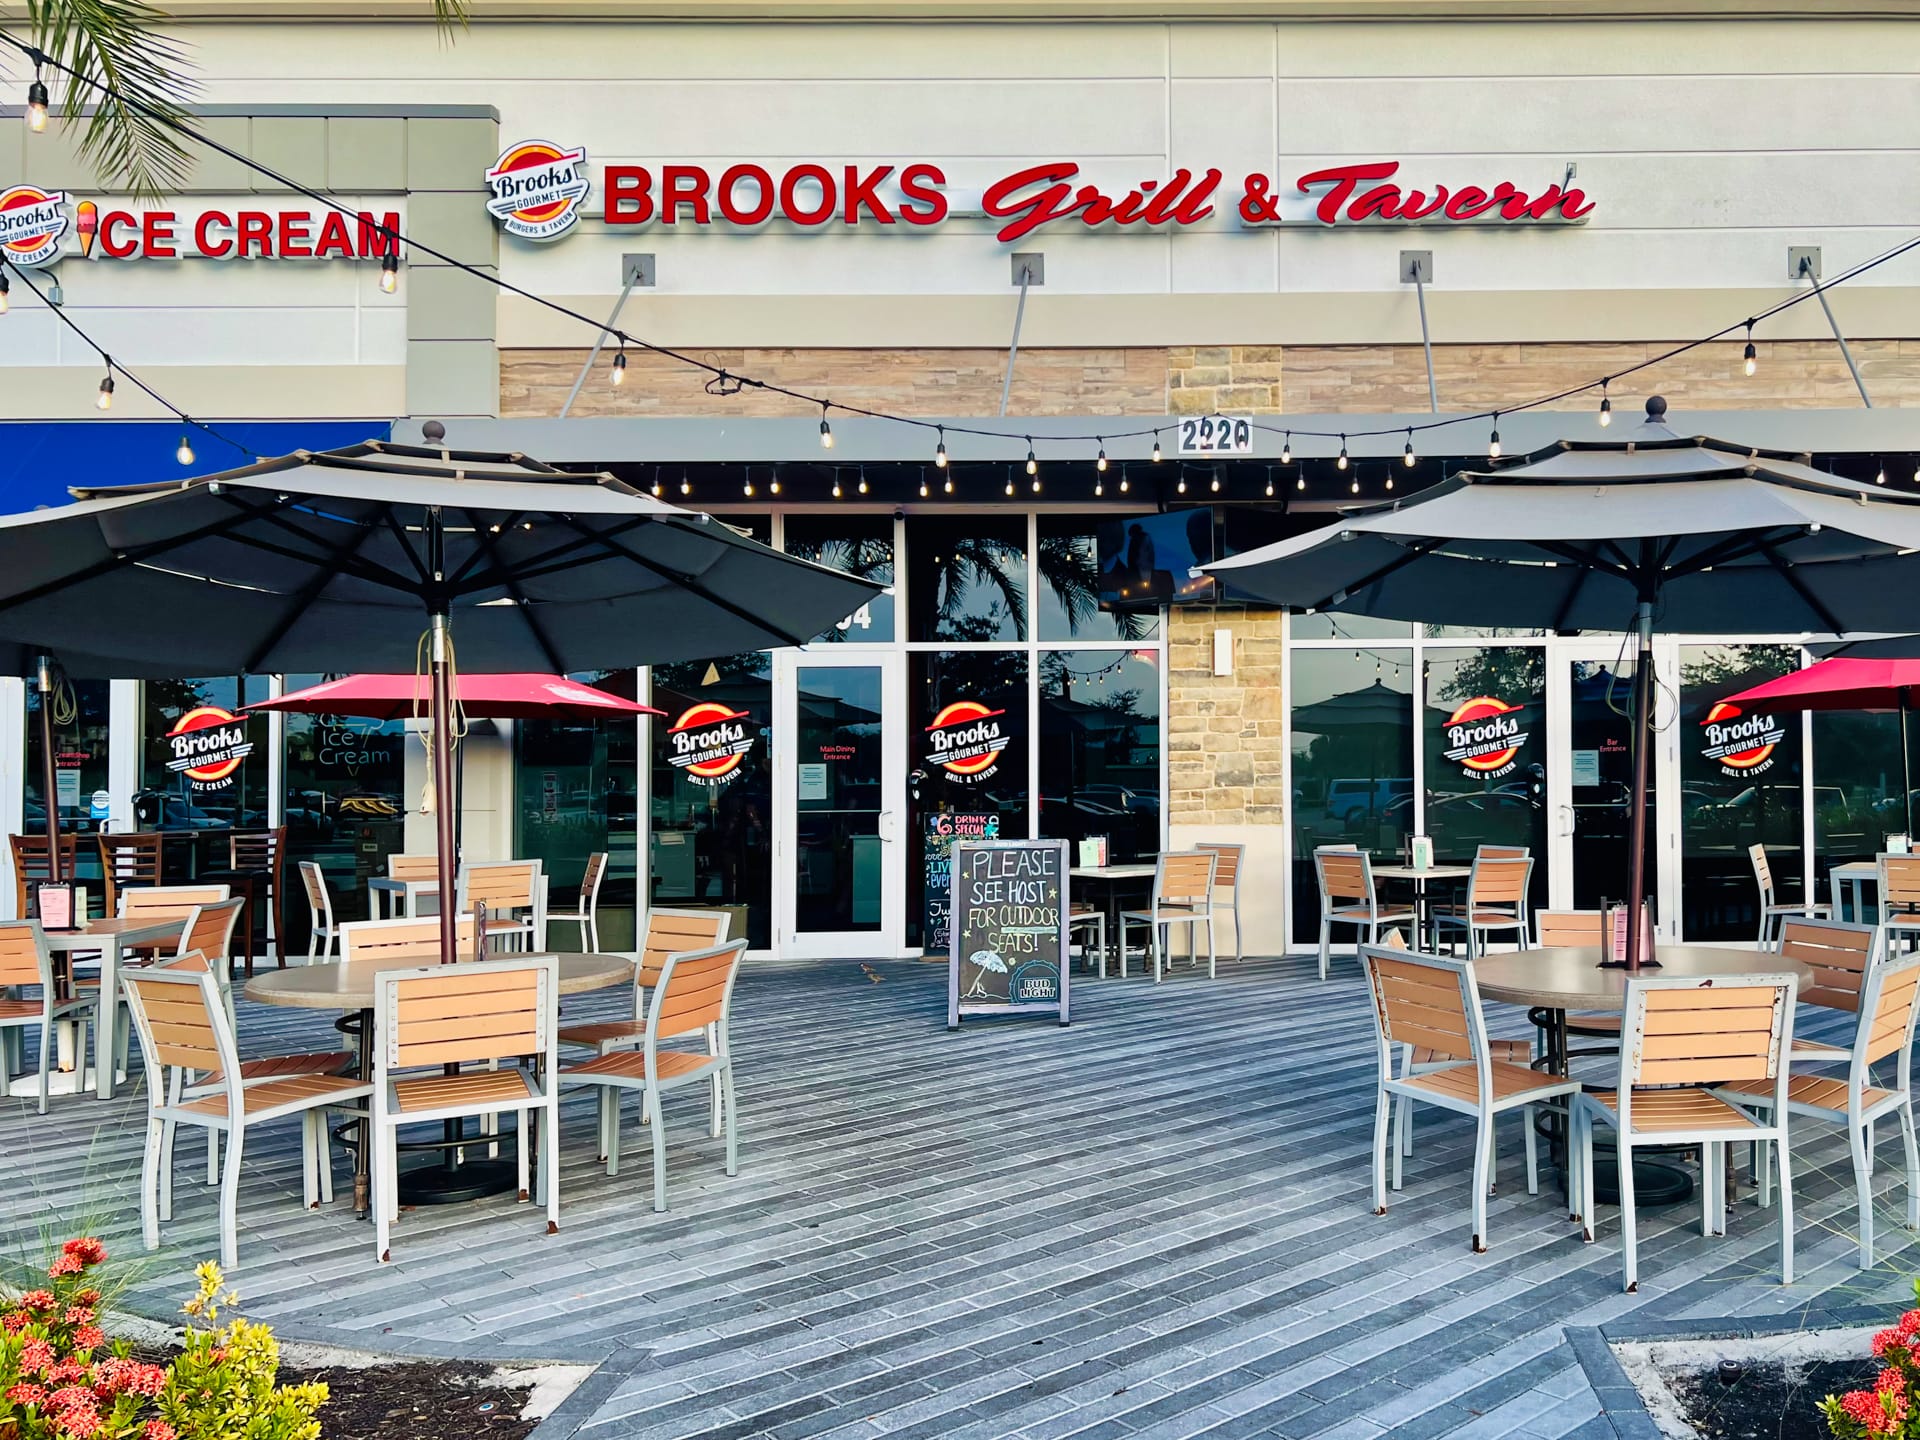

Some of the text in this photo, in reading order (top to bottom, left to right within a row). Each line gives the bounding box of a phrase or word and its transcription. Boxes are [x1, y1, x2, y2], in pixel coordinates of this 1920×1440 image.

[496, 167, 573, 199] Brooks
[517, 190, 561, 209] GOURMET
[604, 161, 1596, 243] BROOKS Grill & Tavern
[0, 207, 54, 232] Brooks
[508, 219, 539, 234] BURGERS
[549, 211, 574, 231] TAVERN
[9, 226, 45, 241] GOURMET
[195, 210, 400, 257] CREAM
[7, 246, 50, 262] ICE CREAM
[1182, 419, 1249, 450] 2220
[322, 730, 355, 746] Ice
[672, 723, 744, 754] Brooks
[930, 721, 1000, 752] Brooks
[1448, 717, 1519, 748] Brooks
[1705, 714, 1775, 747] Brooks
[170, 727, 244, 758] Brooks
[835, 745, 856, 754] Dining
[1466, 740, 1507, 757] GOURMET
[1606, 738, 1618, 746] Bar
[1724, 736, 1764, 755] GOURMET
[190, 749, 232, 768] GOURMET
[319, 748, 391, 765] Cream
[691, 745, 733, 764] GOURMET
[949, 743, 989, 761] GOURMET
[687, 766, 742, 786] GRILL & TAVERN
[945, 764, 998, 784] GRILL & TAVERN
[1462, 761, 1517, 780] GRILL & TAVERN
[1721, 758, 1774, 778] GRILL & TAVERN
[191, 776, 233, 791] ICE CREAM
[954, 815, 987, 824] DRINK
[930, 861, 952, 873] LIV
[973, 850, 1055, 880] PLEASE
[970, 880, 1047, 905] SEE HOST
[969, 906, 997, 929] FOR
[1000, 904, 1060, 927] OUTDOOR
[988, 932, 1039, 954] SEATS!
[1020, 987, 1056, 998] LIGHT
[1024, 979, 1051, 989] BUD
